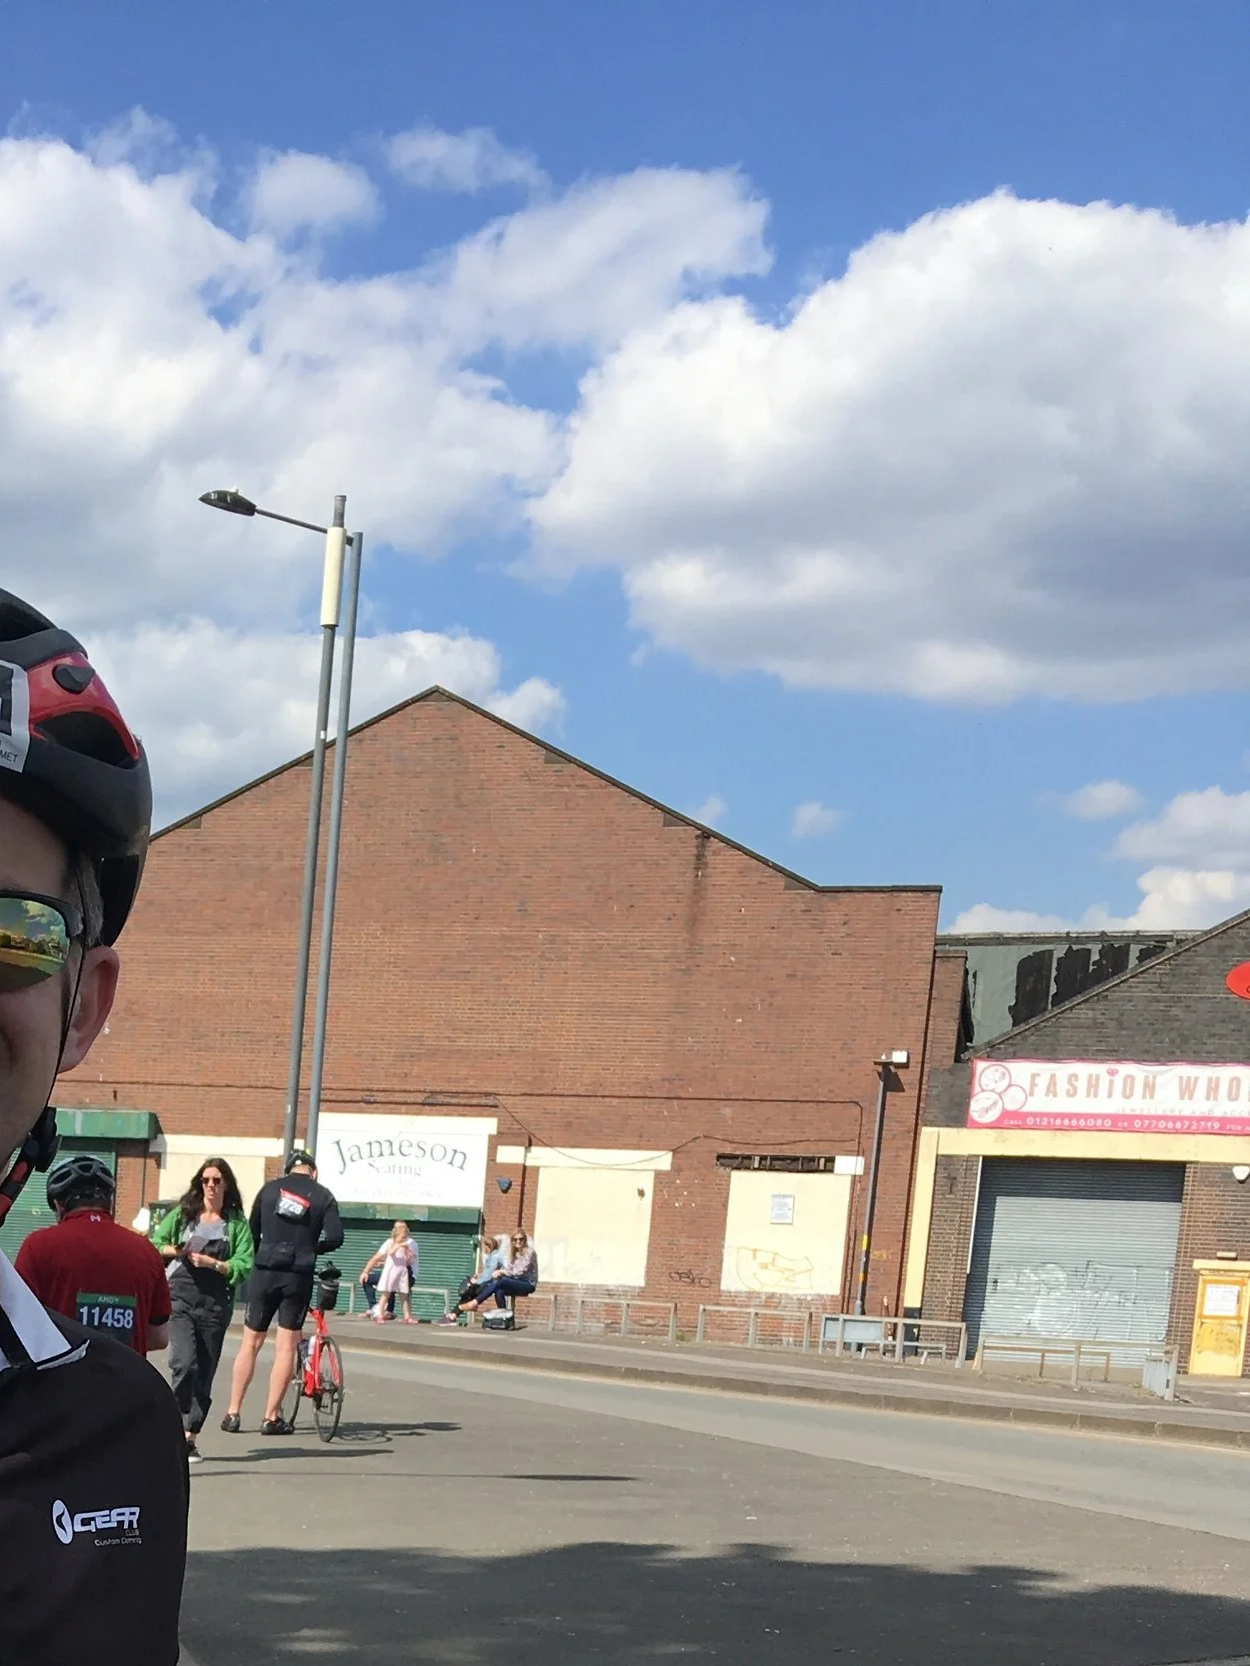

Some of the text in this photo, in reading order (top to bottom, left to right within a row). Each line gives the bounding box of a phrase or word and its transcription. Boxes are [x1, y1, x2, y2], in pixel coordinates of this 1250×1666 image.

[1178, 1075, 1250, 1102] WHO
[331, 1138, 468, 1175] Jameson
[79, 1305, 134, 1329] 11458
